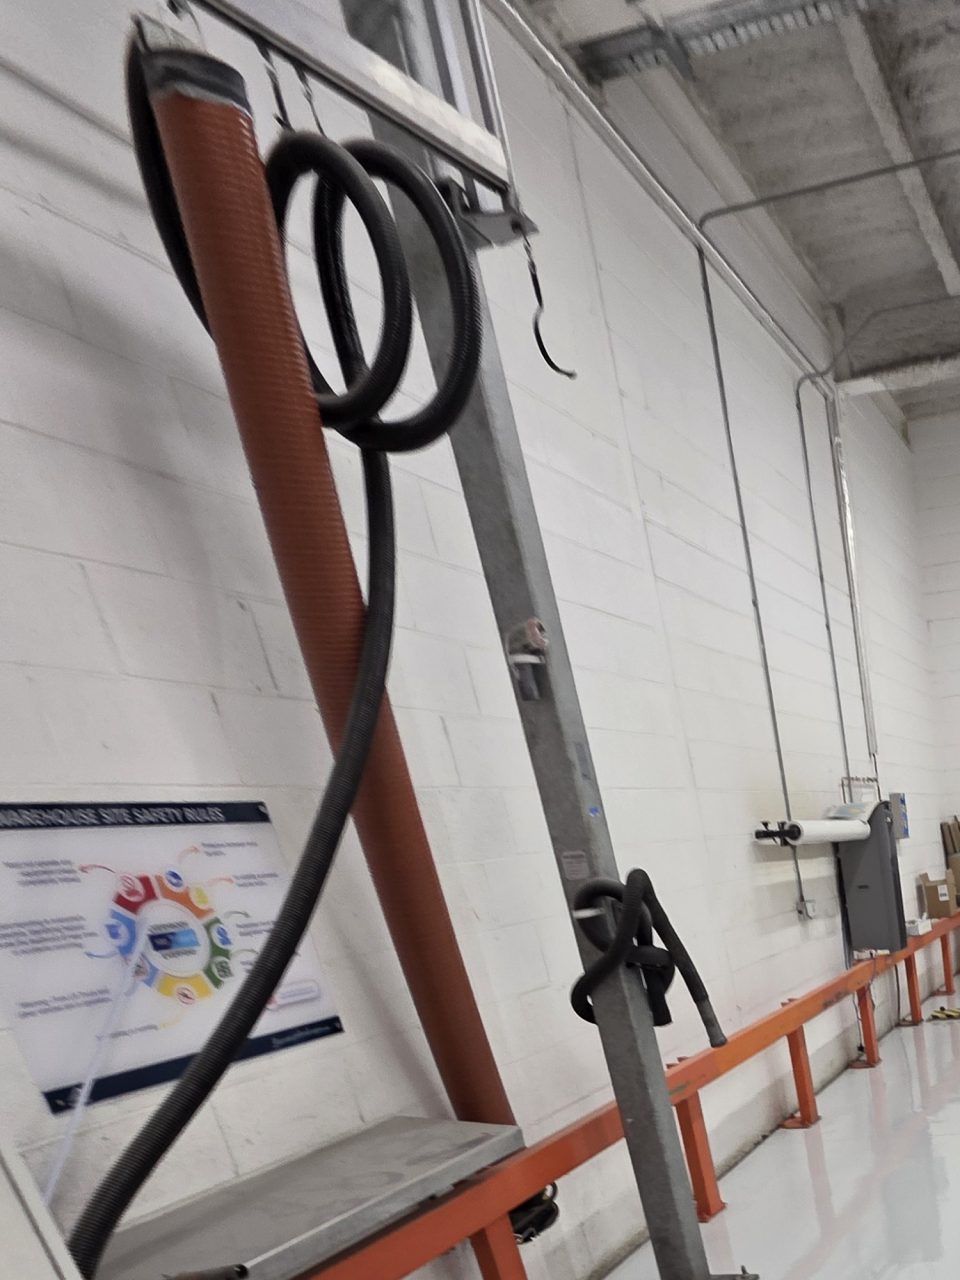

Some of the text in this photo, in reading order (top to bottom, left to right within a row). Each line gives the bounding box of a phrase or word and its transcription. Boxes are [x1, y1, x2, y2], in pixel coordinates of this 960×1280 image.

[97, 807, 134, 825] SITE
[130, 806, 183, 824] SAFETY
[181, 806, 225, 823] RULES
